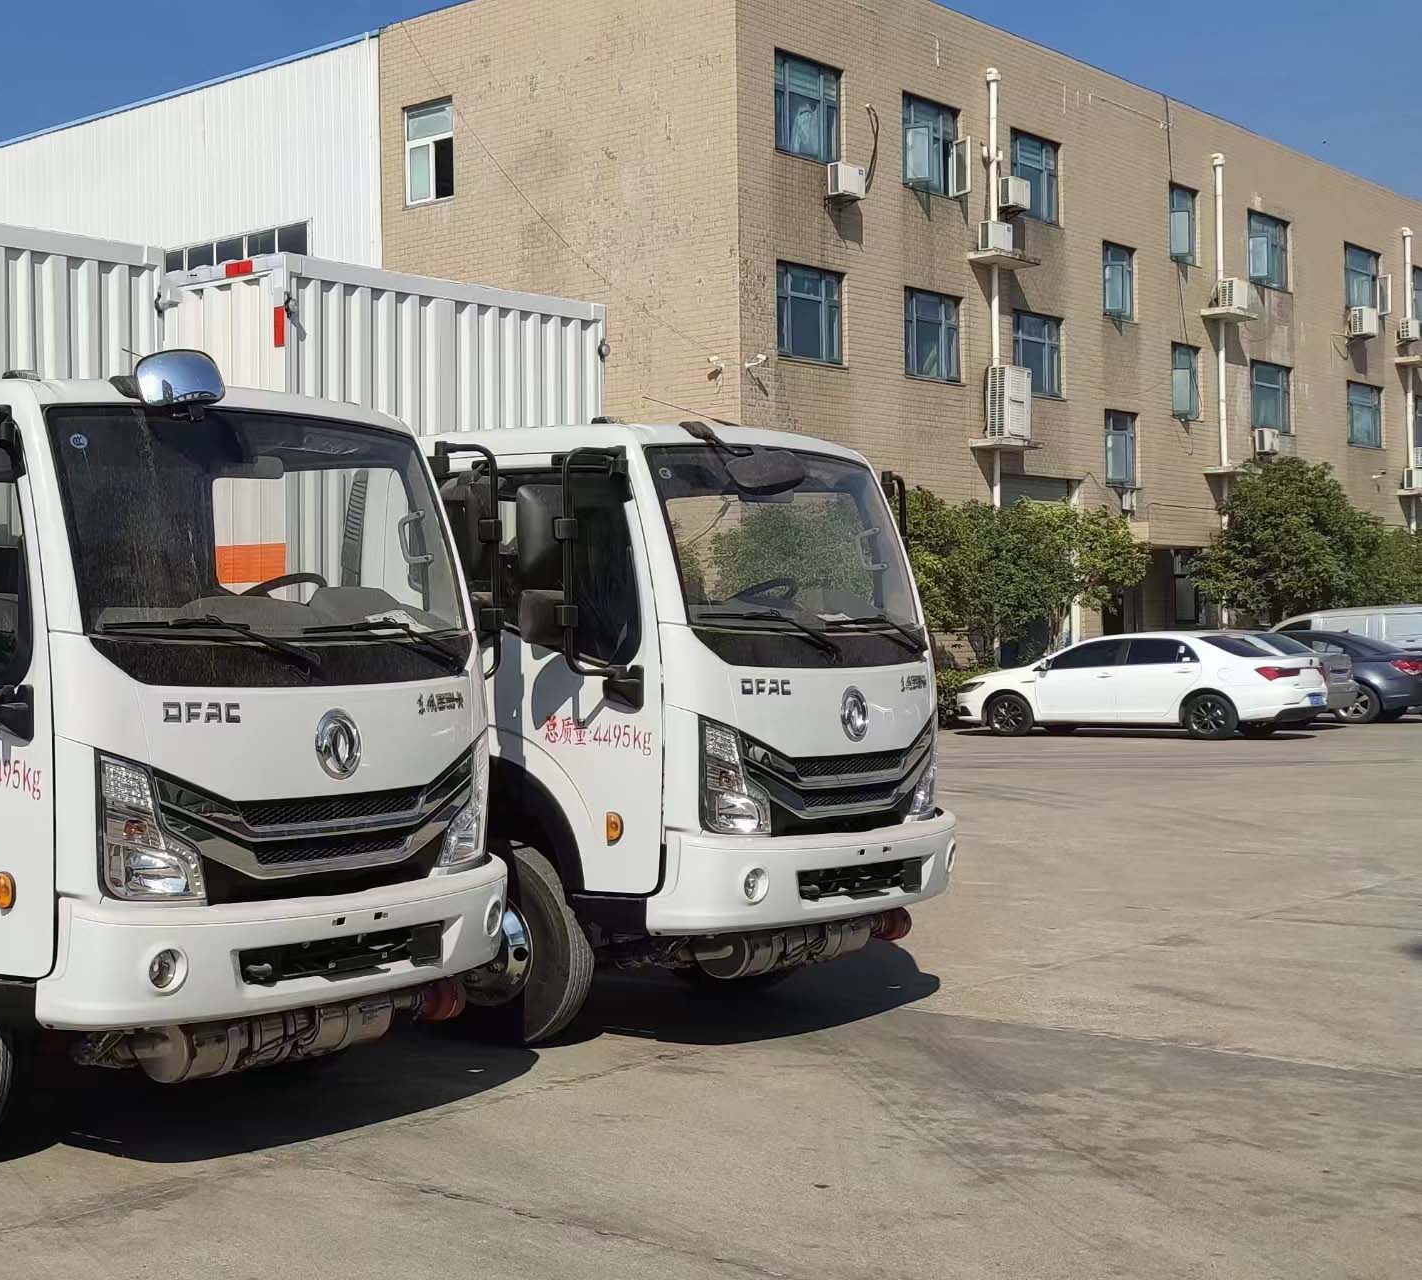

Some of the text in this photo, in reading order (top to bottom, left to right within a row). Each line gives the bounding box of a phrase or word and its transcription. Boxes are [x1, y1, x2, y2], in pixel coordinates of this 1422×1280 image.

[740, 679, 791, 696] DFAC
[162, 702, 241, 723] DFAC
[545, 715, 653, 757] 总质量:4495kg
